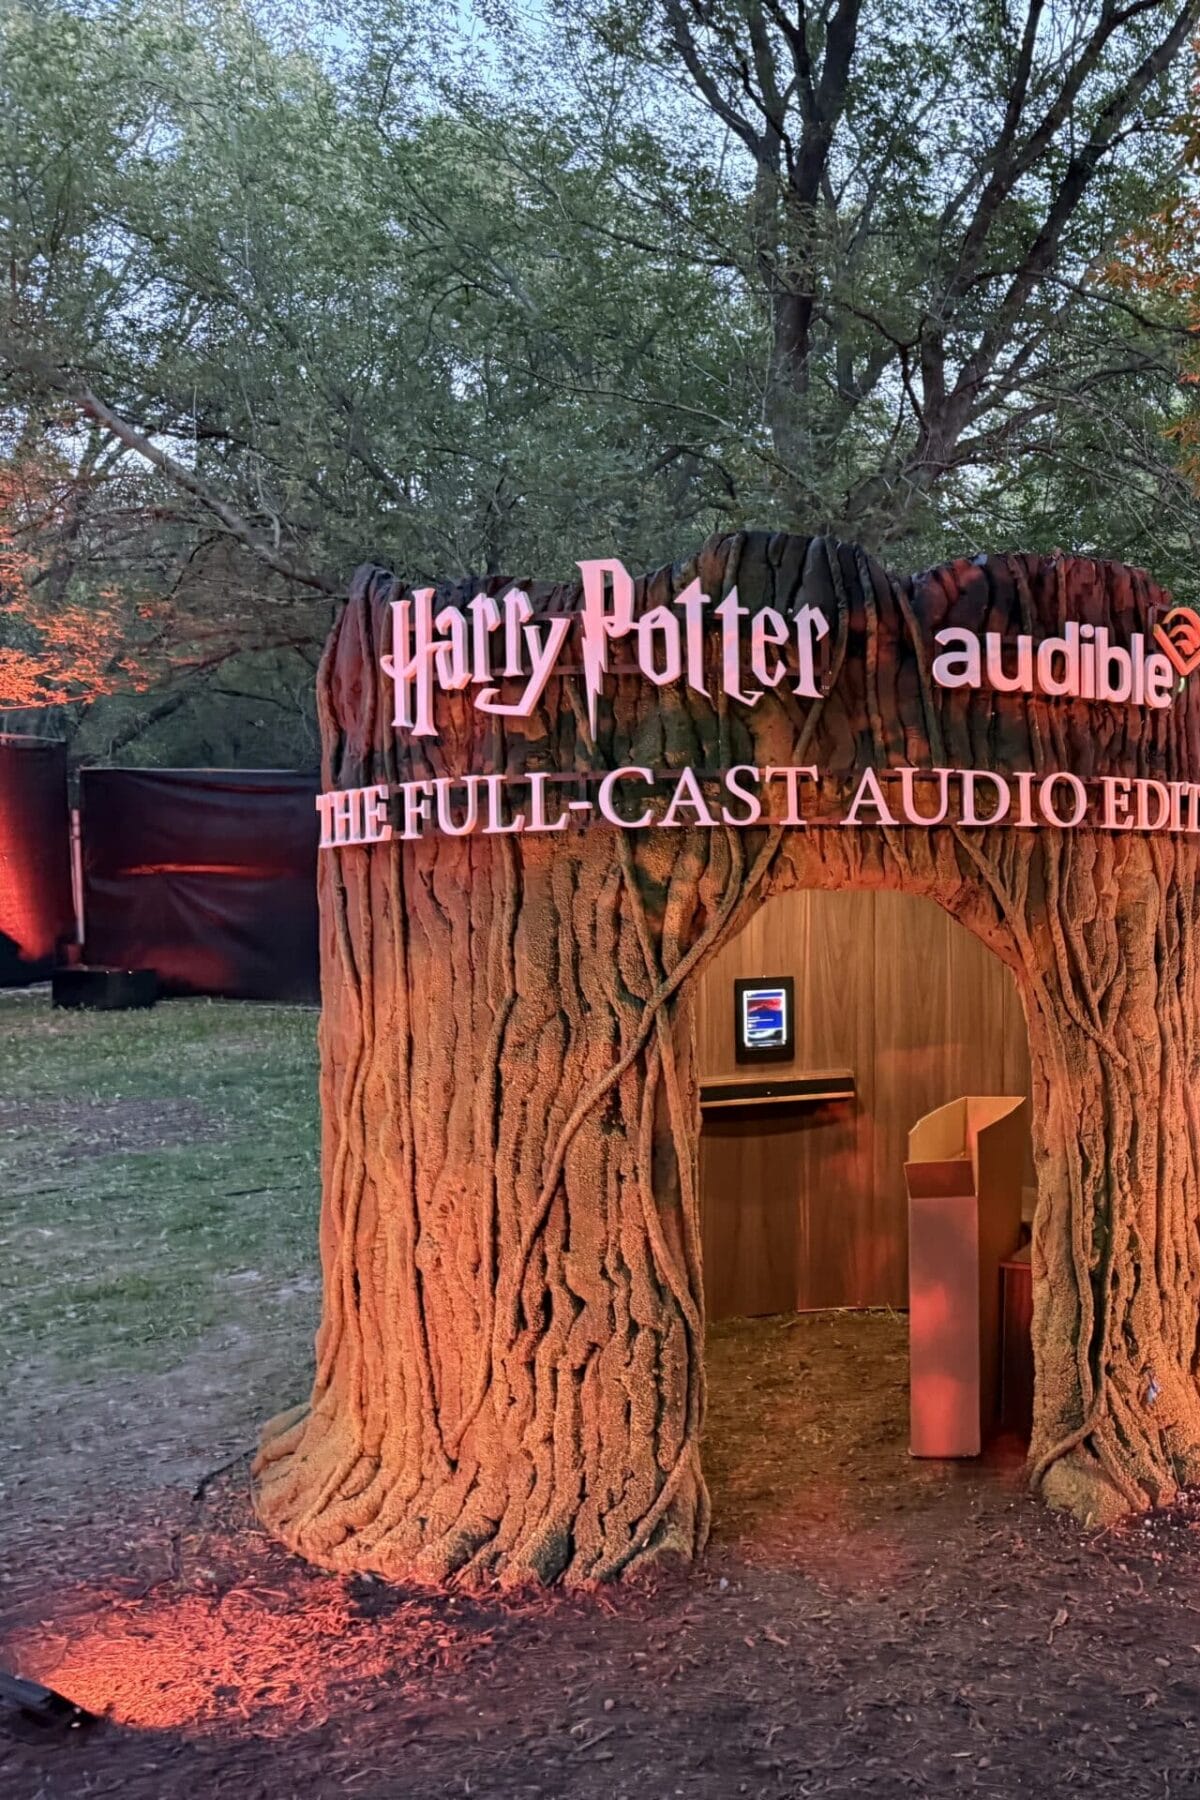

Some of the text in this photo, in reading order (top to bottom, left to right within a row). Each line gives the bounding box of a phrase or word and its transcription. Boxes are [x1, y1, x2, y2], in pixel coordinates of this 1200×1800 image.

[380, 558, 829, 741] Harry Potter
[932, 621, 1173, 709] audible
[316, 784, 392, 849] THE
[399, 765, 818, 841] FULL-CAST
[840, 767, 1087, 828] AUDIO
